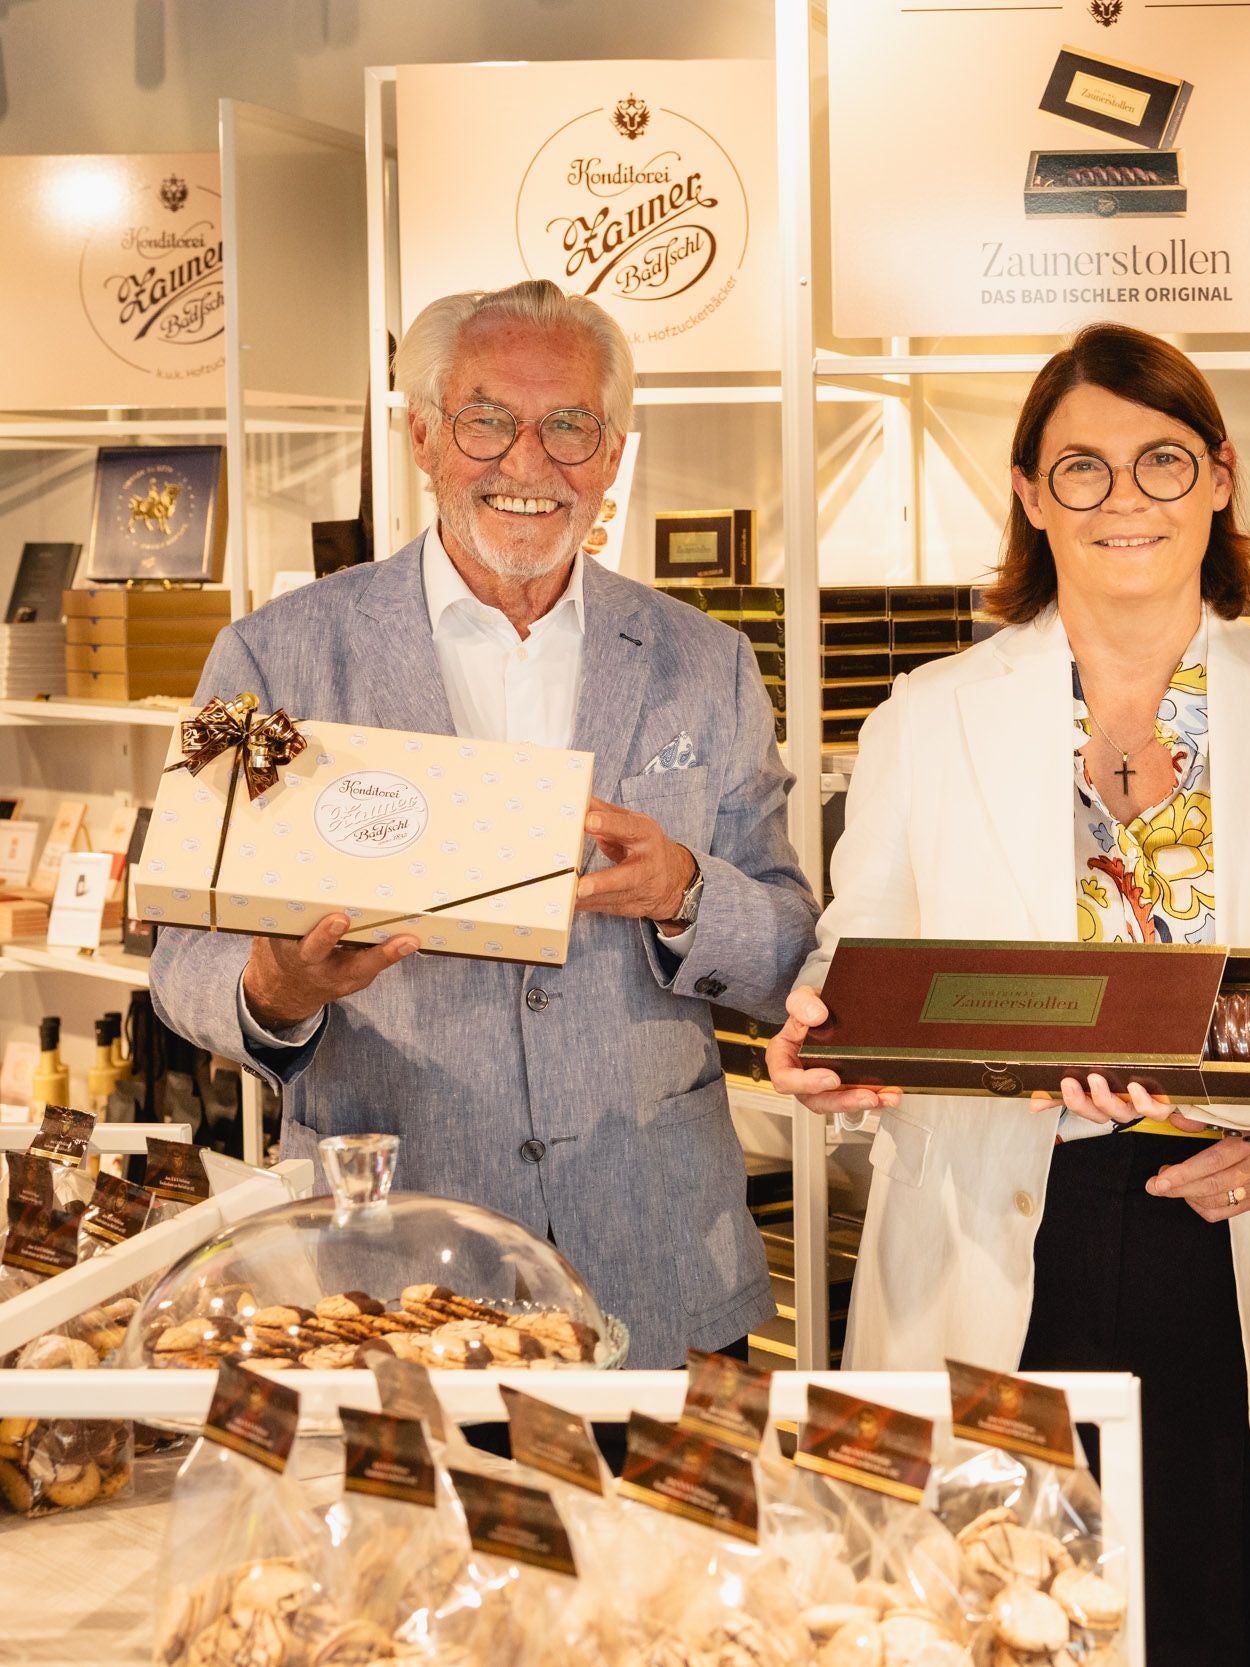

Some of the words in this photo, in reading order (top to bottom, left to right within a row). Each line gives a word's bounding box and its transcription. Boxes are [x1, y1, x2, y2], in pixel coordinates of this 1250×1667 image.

[1081, 88, 1135, 113] Zaunerstollen
[568, 152, 679, 196] Konditorei
[121, 222, 211, 258] Konditorei
[546, 173, 718, 276] Zauner
[982, 239, 1232, 278] Zaunerstollen
[648, 275, 737, 342] Hofzuckerbäcker
[981, 289, 1016, 305] DAS
[1022, 288, 1057, 304] BAD
[1064, 287, 1139, 303] ISCHLER
[1145, 286, 1233, 303] ORIGINAL
[339, 781, 405, 800] Konditorei
[952, 994, 1079, 1010] Zaunerstollen
